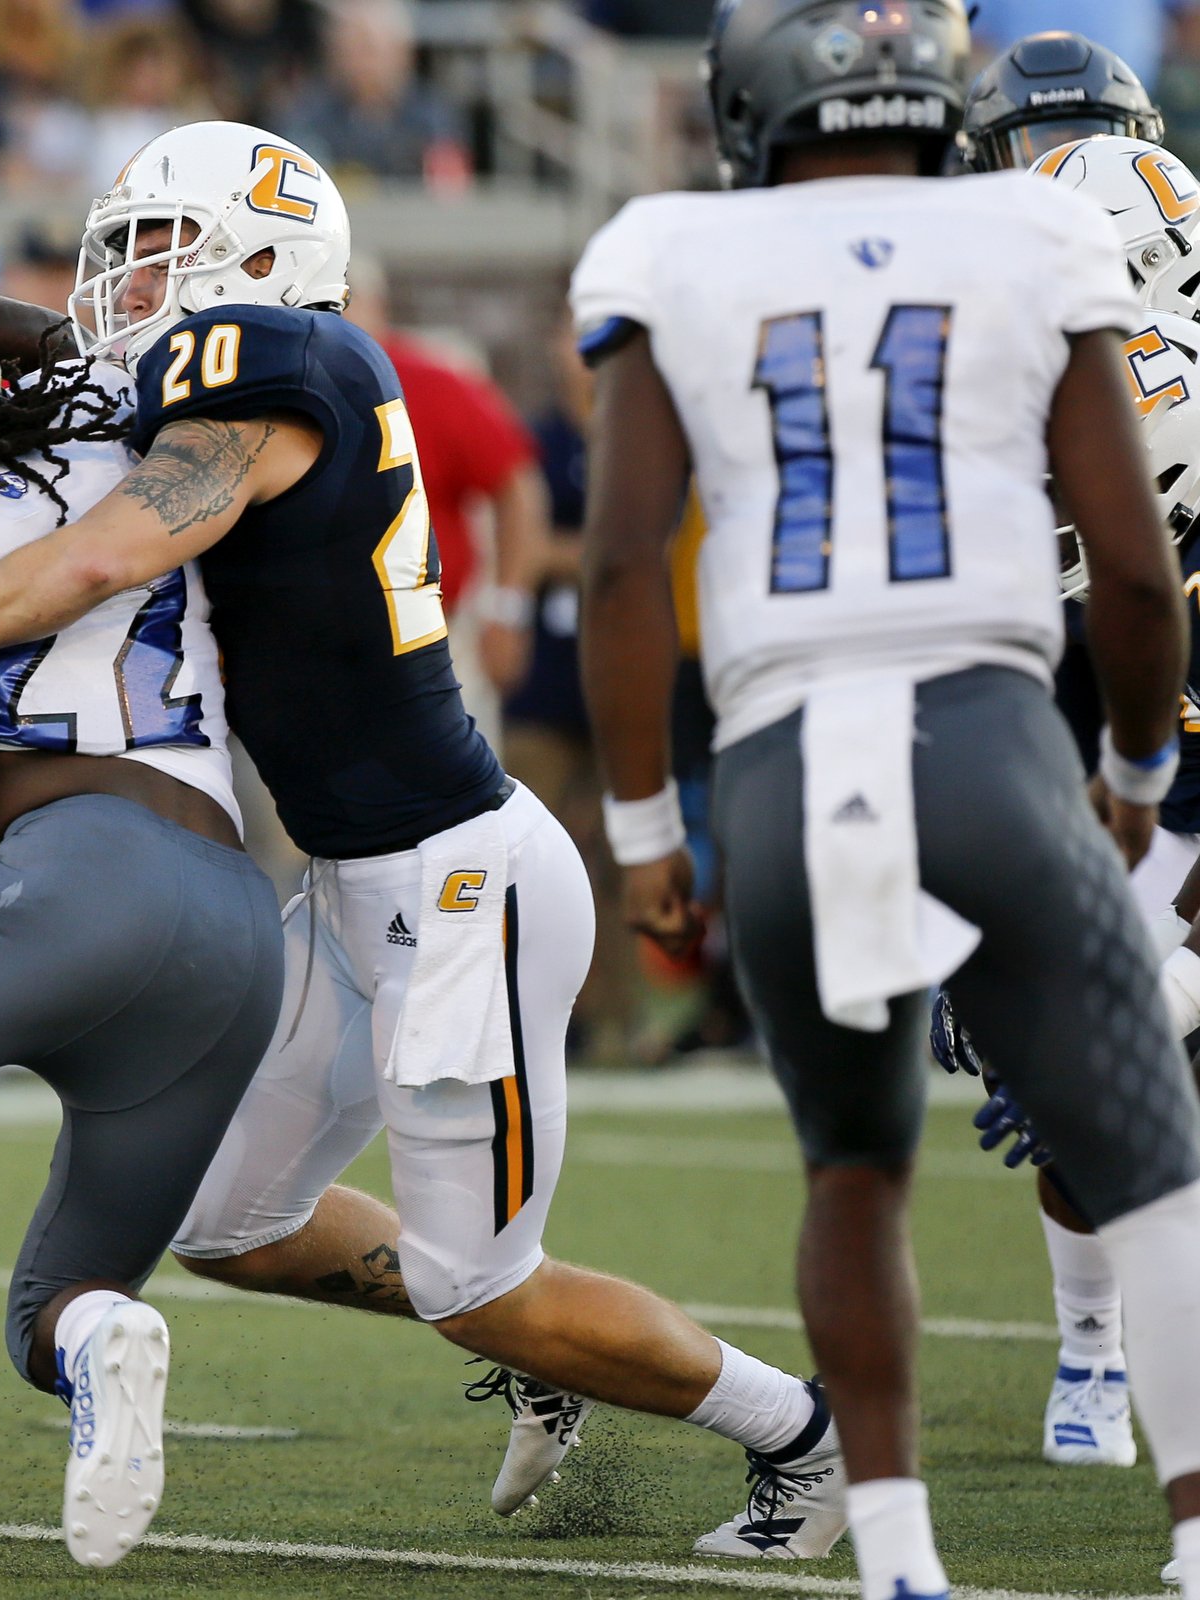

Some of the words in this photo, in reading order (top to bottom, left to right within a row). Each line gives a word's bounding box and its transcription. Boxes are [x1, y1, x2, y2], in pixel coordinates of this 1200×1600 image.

[819, 95, 946, 133] Riddell
[247, 143, 320, 225] C
[162, 324, 241, 408] 20
[753, 303, 956, 594] 11
[437, 869, 487, 912] C
